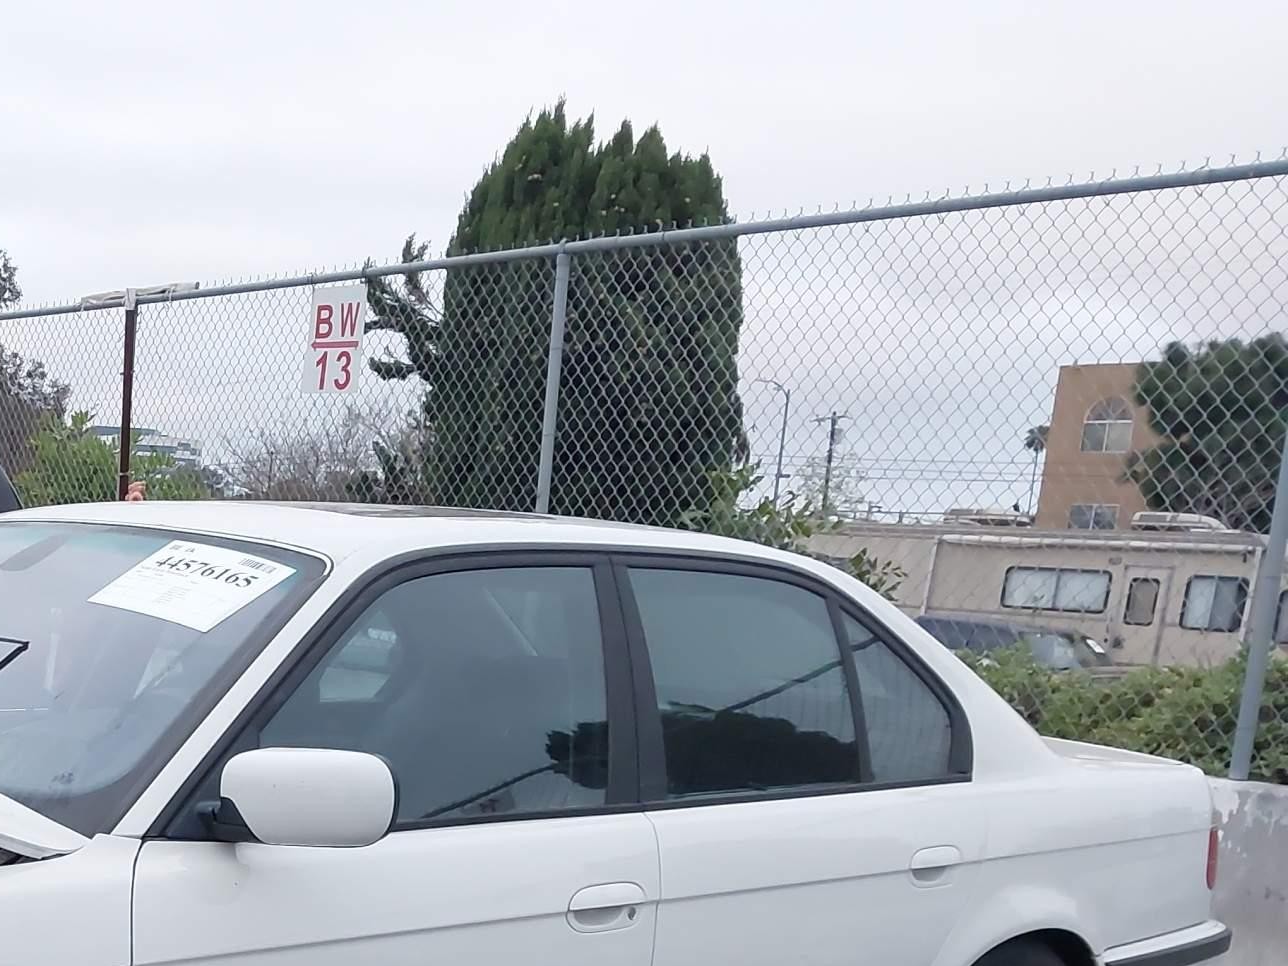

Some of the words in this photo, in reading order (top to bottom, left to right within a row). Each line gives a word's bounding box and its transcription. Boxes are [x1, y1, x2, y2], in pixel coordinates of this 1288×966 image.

[315, 302, 361, 339] BW
[316, 350, 352, 390] 13
[155, 555, 260, 588] 44576165
